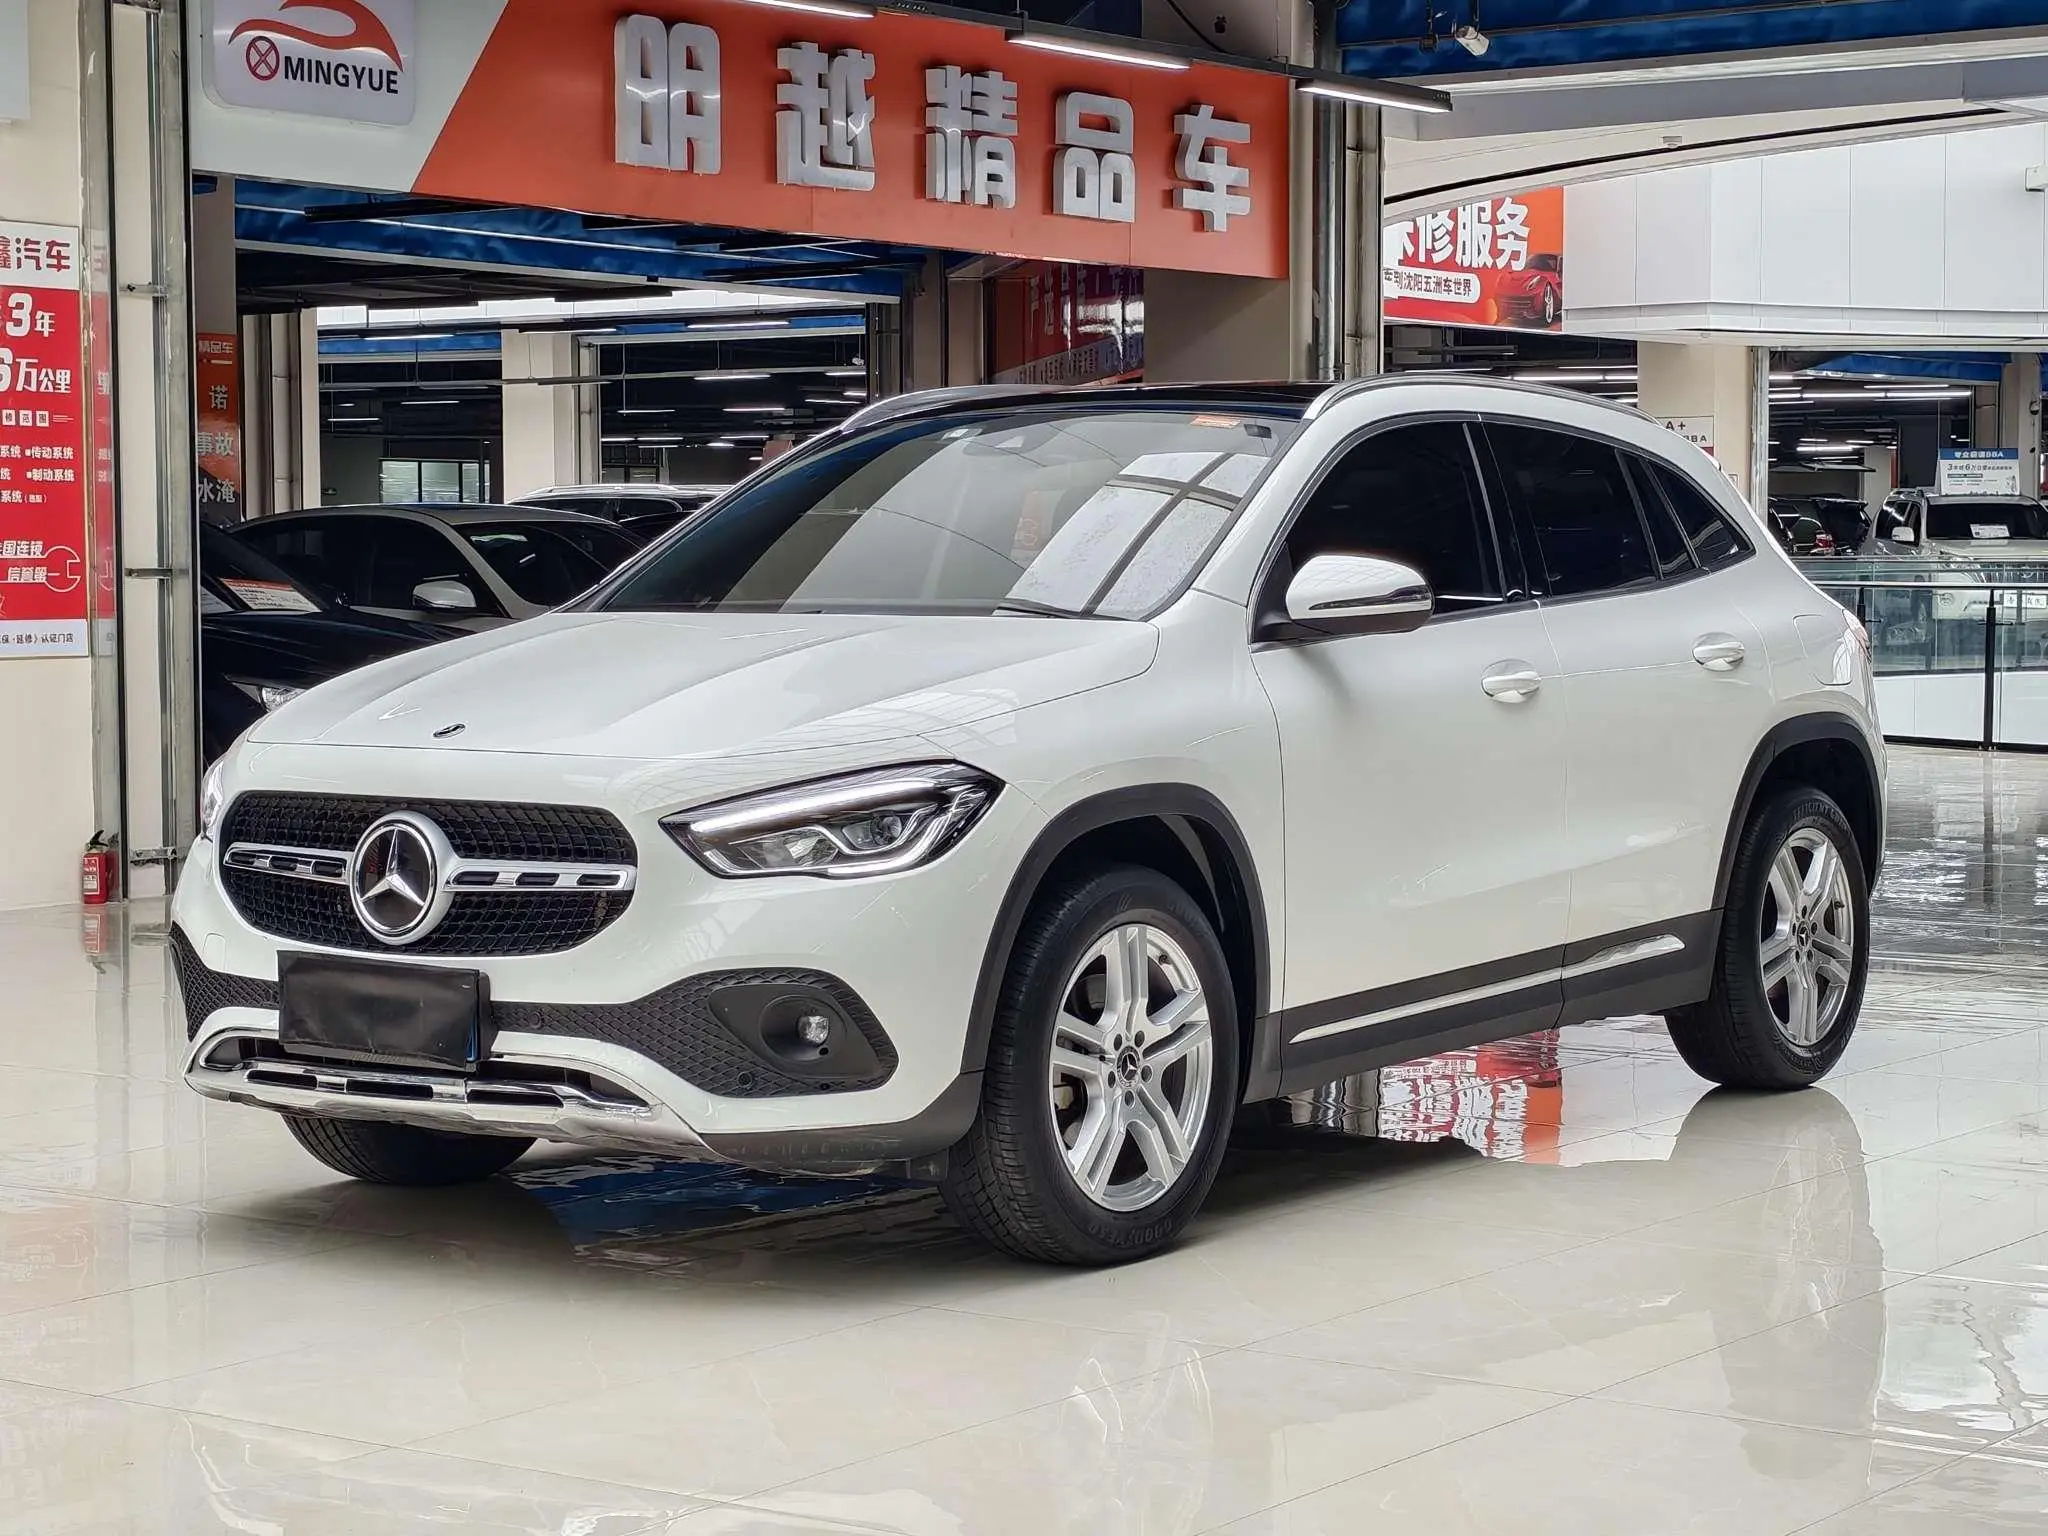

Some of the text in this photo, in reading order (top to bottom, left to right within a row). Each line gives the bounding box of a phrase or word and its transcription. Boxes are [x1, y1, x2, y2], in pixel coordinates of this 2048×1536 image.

[284, 55, 399, 94] MINGYUE
[614, 14, 1252, 232] 明越精品车
[6, 293, 55, 337] 3年
